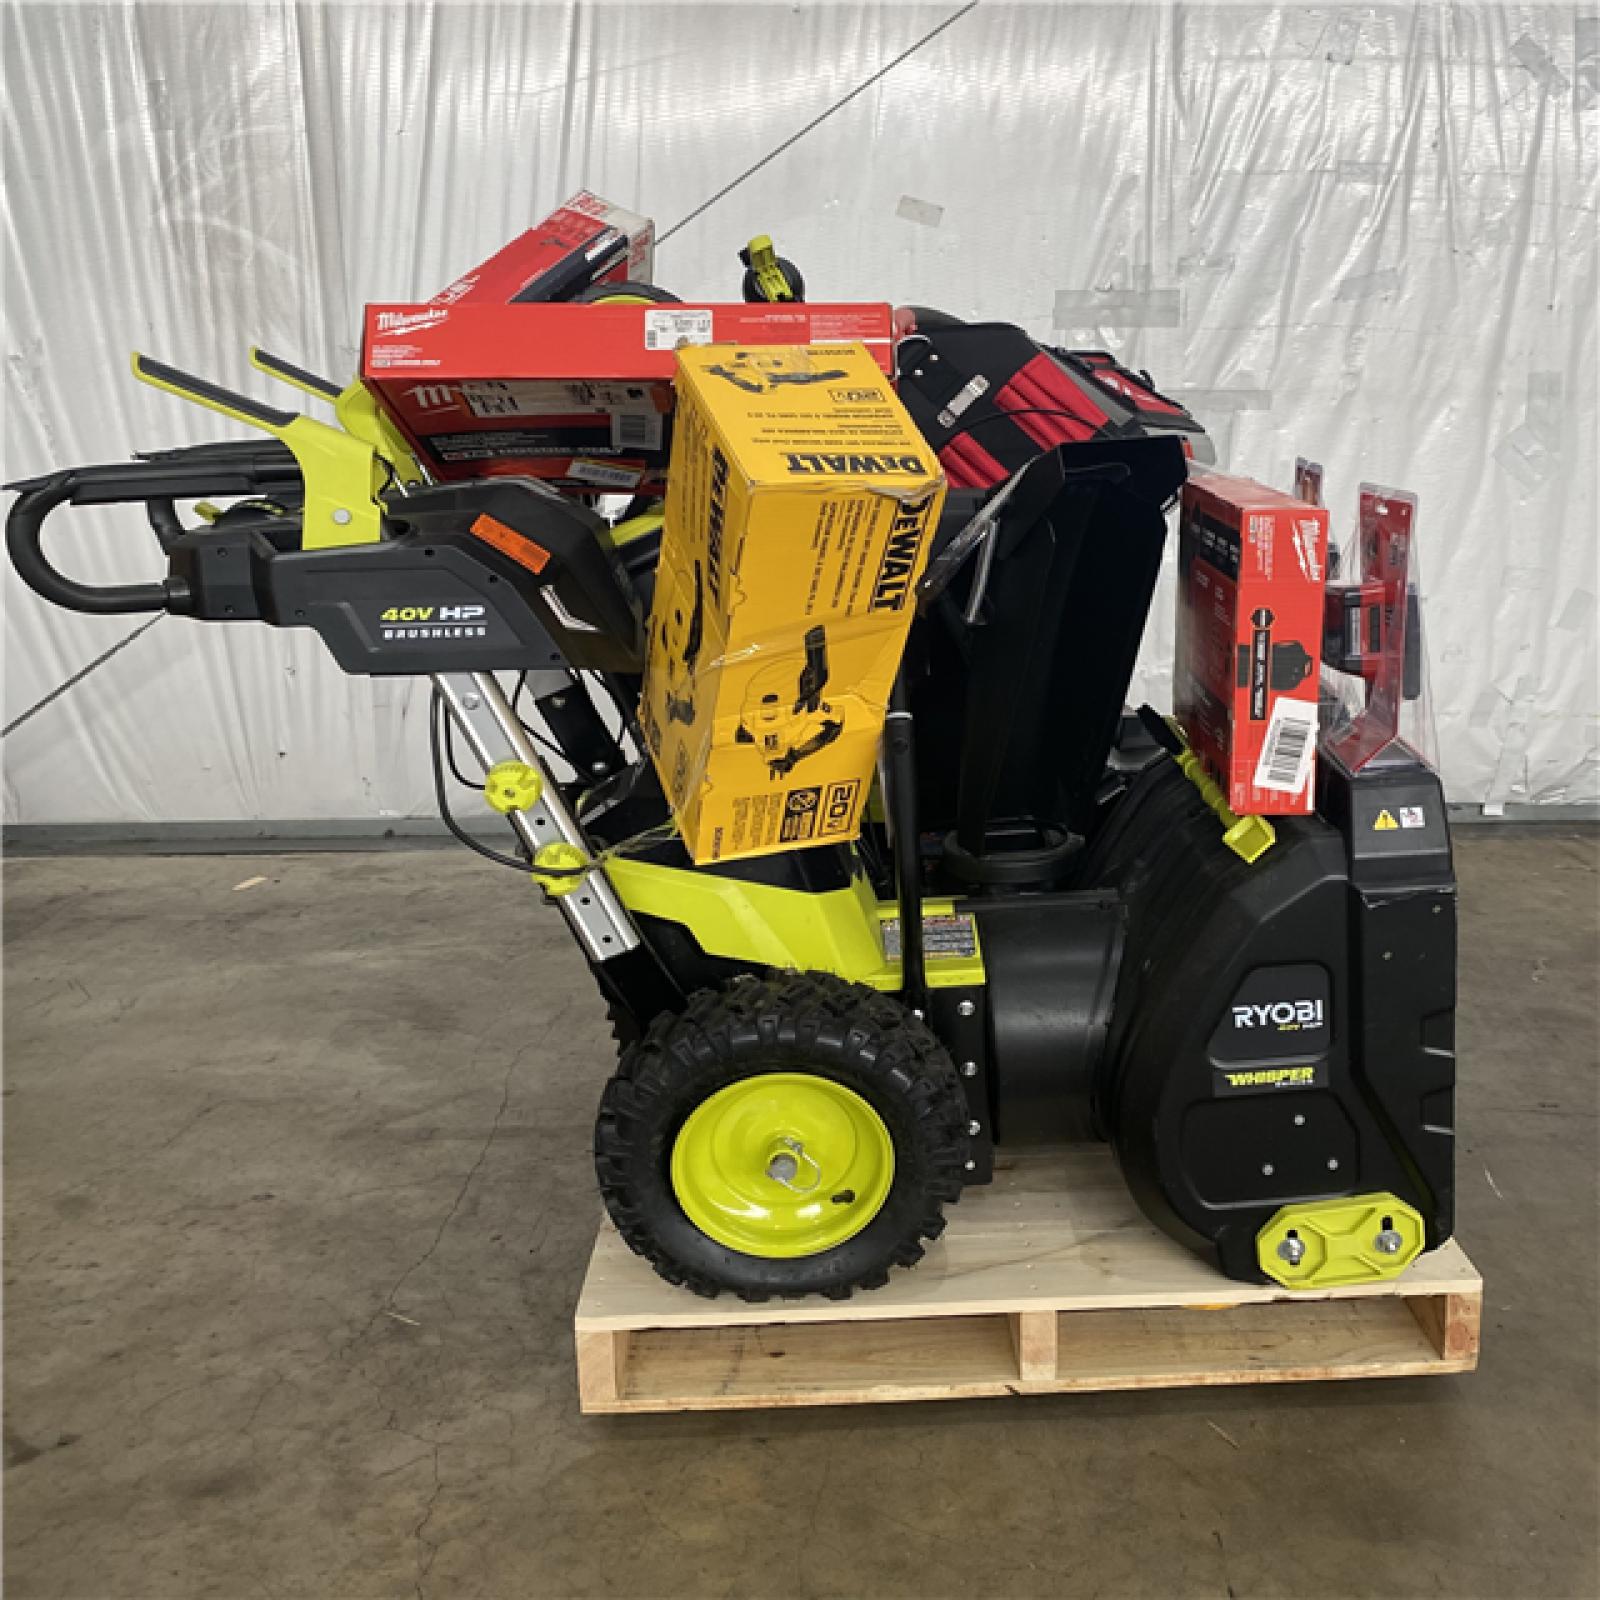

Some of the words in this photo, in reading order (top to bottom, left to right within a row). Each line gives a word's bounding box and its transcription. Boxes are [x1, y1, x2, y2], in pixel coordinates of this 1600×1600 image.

[375, 309, 448, 331] Milwaukee
[380, 607, 434, 621] 40V
[439, 605, 486, 621] HP
[383, 627, 486, 641] BRUSHLESS
[1231, 999, 1324, 1029] RYOBI
